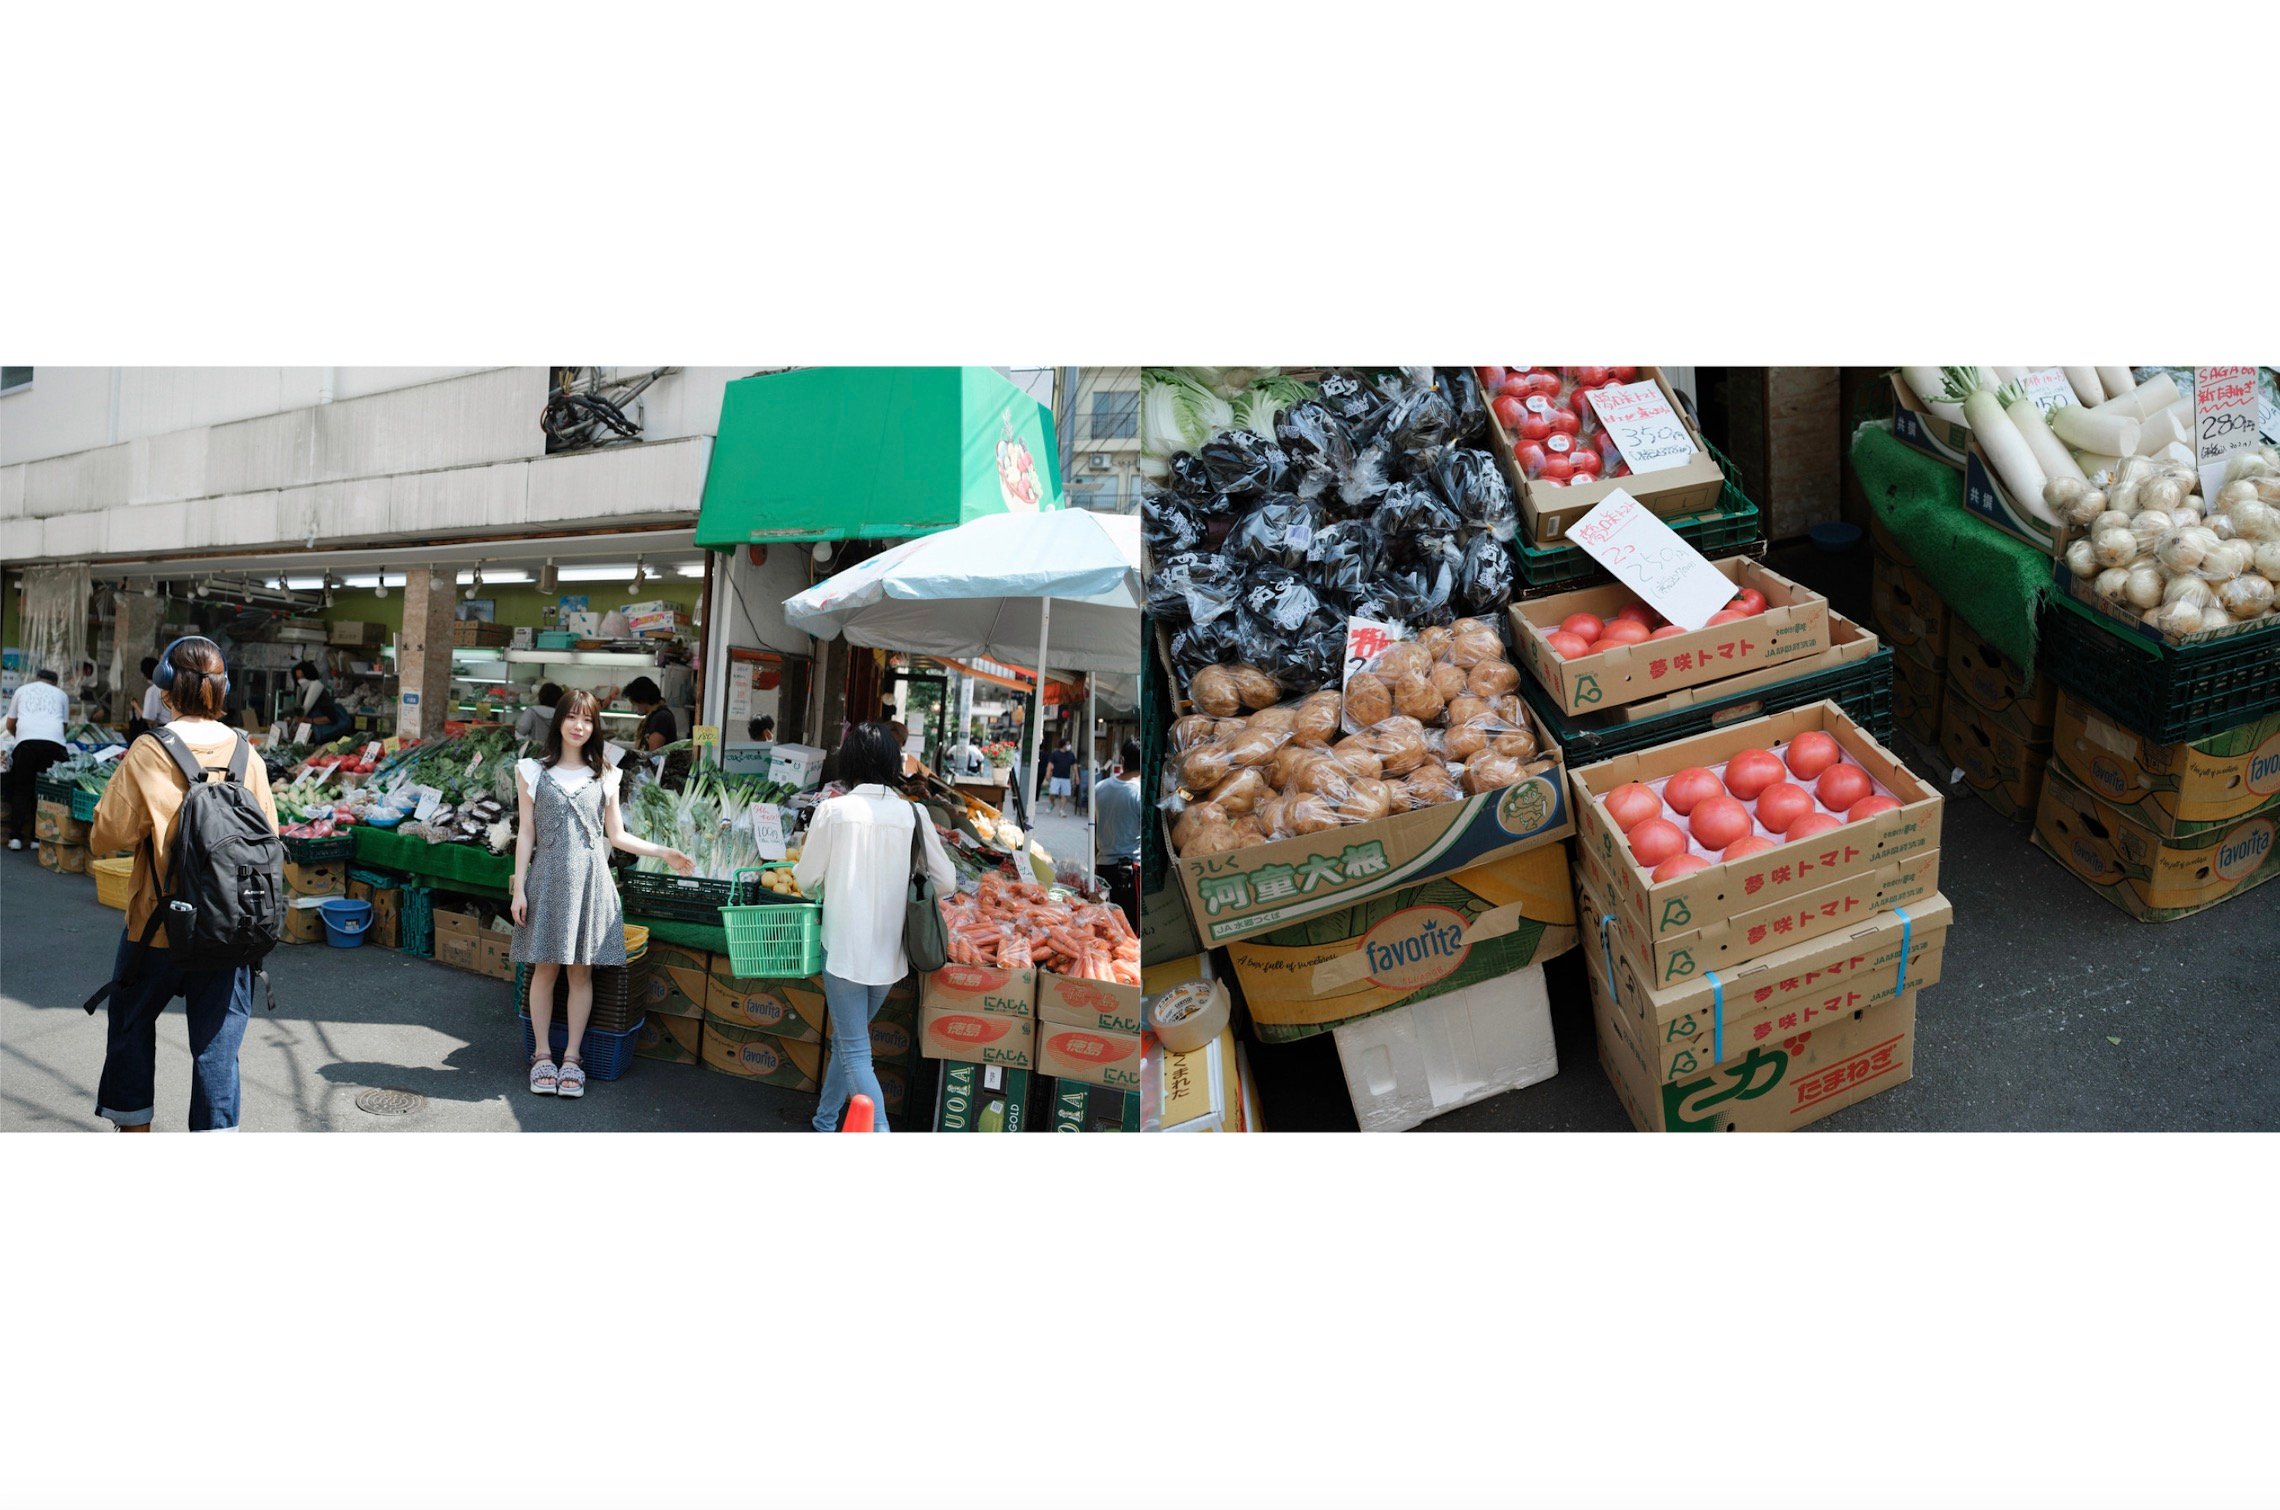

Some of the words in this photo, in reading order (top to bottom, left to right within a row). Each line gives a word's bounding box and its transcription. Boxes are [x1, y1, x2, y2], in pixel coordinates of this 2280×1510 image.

[1649, 638, 1756, 680] 夢咲トマト
[2091, 761, 2125, 792] favorita
[1190, 855, 1239, 877] うしく
[2219, 829, 2270, 869] favorita
[1197, 839, 1390, 916] 河童大根
[1744, 845, 1860, 896] 夢咲トマト
[1746, 895, 1860, 945] 夢咲トマト
[1366, 923, 1463, 975] favorita
[1263, 961, 1284, 973] full
[1286, 963, 1296, 973] of
[1753, 956, 1865, 1004] 夢咲トマト
[746, 998, 780, 1019] favorita
[984, 996, 1029, 1012] にんじん
[1753, 991, 1862, 1041] 夢咲トマト
[947, 1022, 982, 1037] 徳島
[742, 1047, 777, 1069] favorita
[982, 1047, 1029, 1063] にんじん
[1066, 1038, 1105, 1057] 徳島
[1171, 1053, 1191, 1101] くまれた
[1797, 1043, 1898, 1104] たまねぎ
[1009, 1104, 1020, 1132] GOLD
